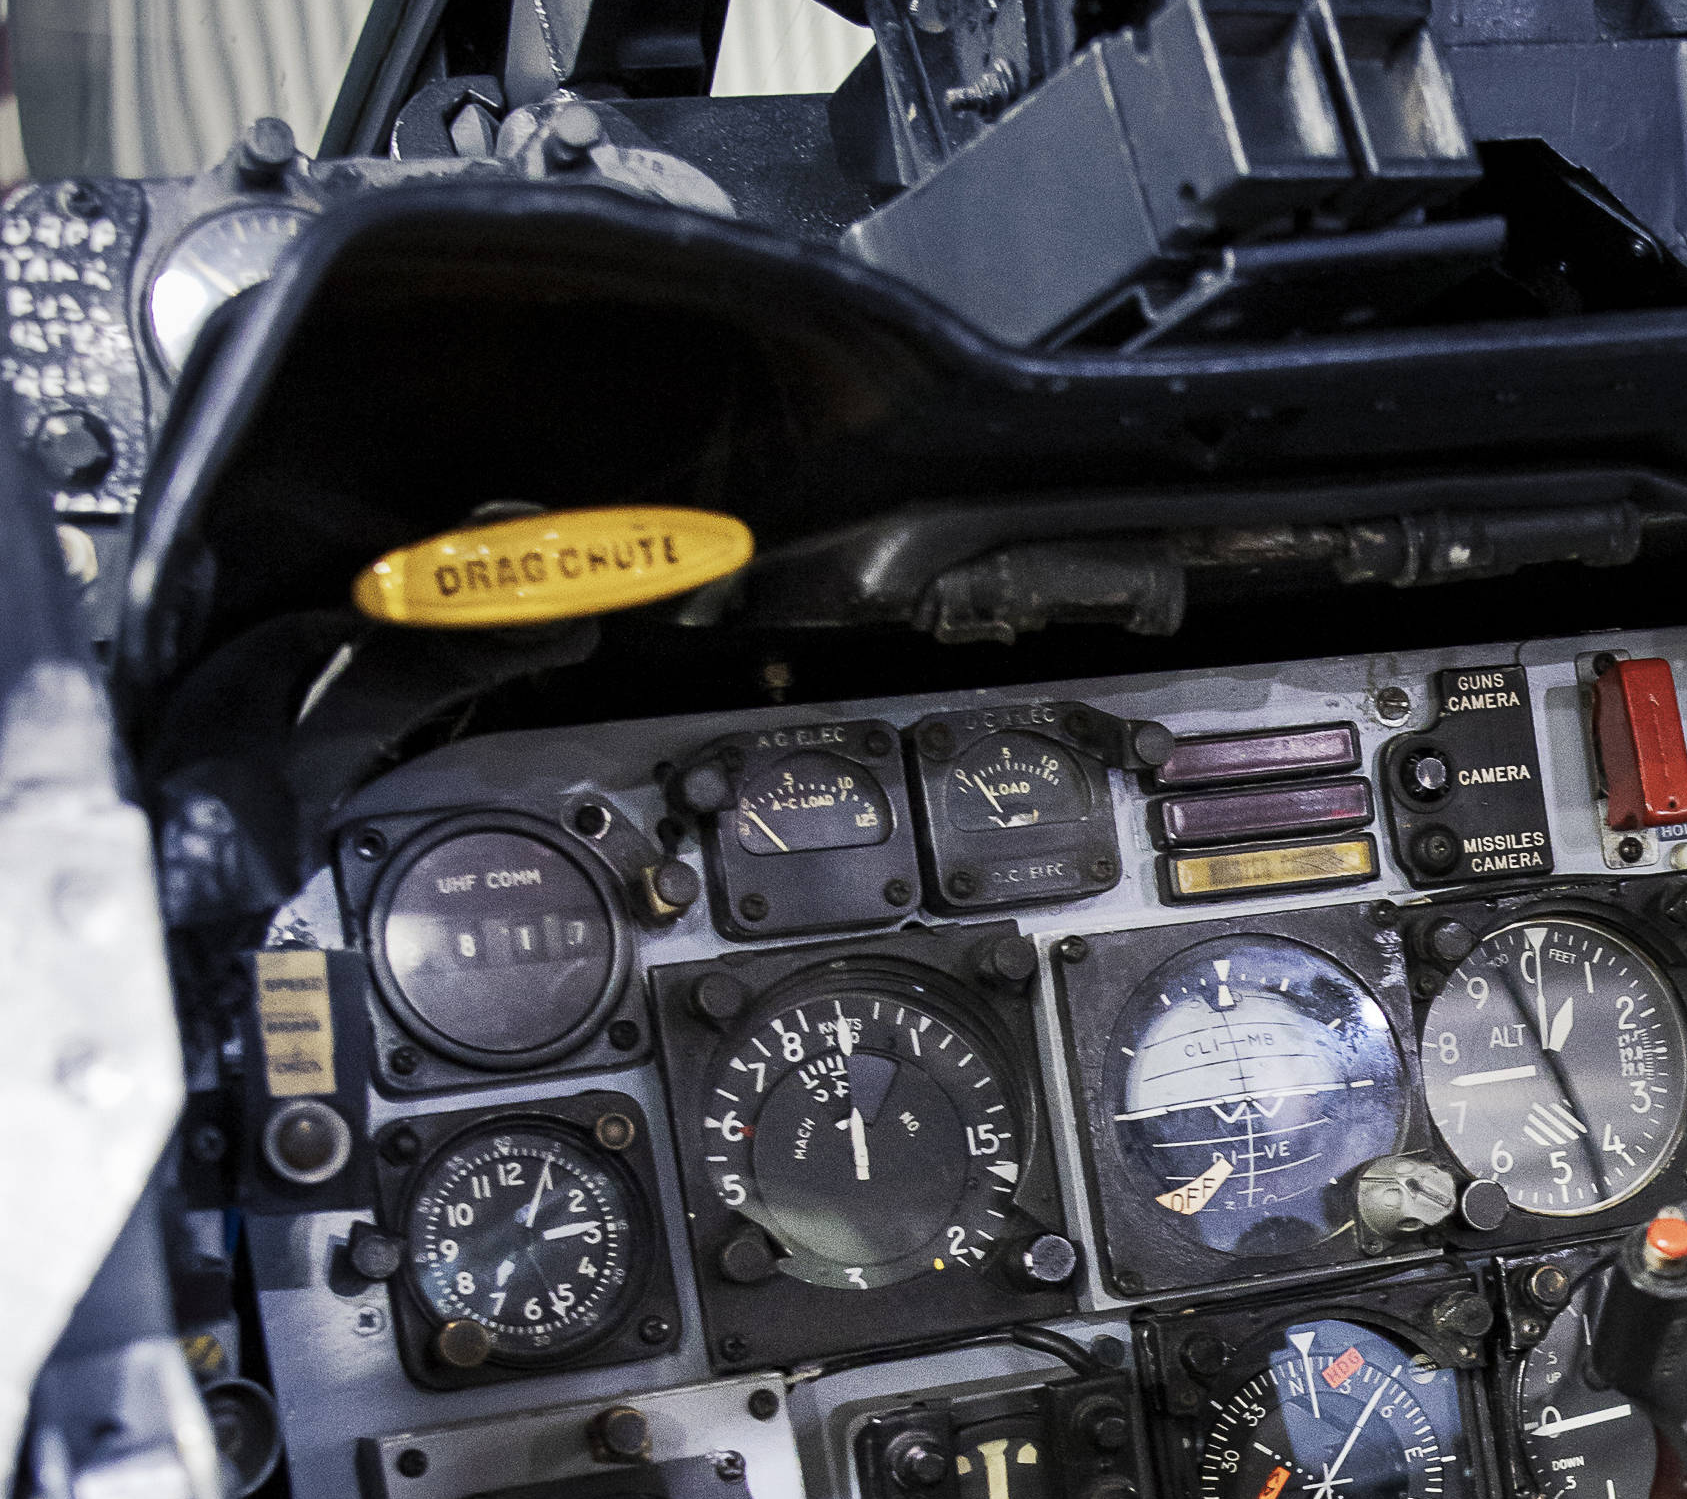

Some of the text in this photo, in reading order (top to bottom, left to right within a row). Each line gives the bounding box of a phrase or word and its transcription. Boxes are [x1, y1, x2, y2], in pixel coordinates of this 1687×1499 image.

[434, 552, 547, 596] DRAG
[1457, 673, 1505, 691] GUNS
[1448, 691, 1521, 712] CAMERA
[1458, 765, 1531, 786] CAMERA
[800, 794, 834, 809] LOAD
[989, 781, 1030, 797] LOAD
[1463, 832, 1545, 853] MISSILES
[1471, 852, 1543, 873] CAMERA
[436, 868, 542, 894] UHF COMM
[1549, 948, 1577, 965] FEET
[1584, 961, 1594, 994] 1
[1467, 976, 1490, 1009] 9
[1615, 995, 1637, 1030] 2
[781, 1032, 804, 1063] 8
[1438, 1032, 1460, 1064] 8
[1490, 1023, 1526, 1049] ALT
[747, 1062, 766, 1093] 7
[1629, 1080, 1651, 1114] 3
[721, 1110, 745, 1141] 6
[1449, 1100, 1467, 1134] 7
[794, 1117, 815, 1160] MACH
[1603, 1123, 1626, 1154] 4
[1491, 1139, 1513, 1174] 6
[1550, 1151, 1573, 1185] 5
[471, 1174, 491, 1199] 11
[498, 1162, 525, 1186] 12
[568, 1189, 587, 1213] 2
[723, 1174, 746, 1205] 5
[1170, 1177, 1216, 1213] OFF
[446, 1202, 474, 1227] 10
[439, 1239, 459, 1263] 9
[947, 1226, 969, 1255] 2
[577, 1256, 597, 1278] 4
[456, 1271, 476, 1295] 8
[524, 1297, 543, 1320] 6
[1324, 1351, 1360, 1385] HDG
[1546, 1371, 1562, 1384] UP
[1243, 1406, 1266, 1427] 33
[1221, 1450, 1240, 1473] 30
[1551, 1455, 1585, 1471] DOWN
